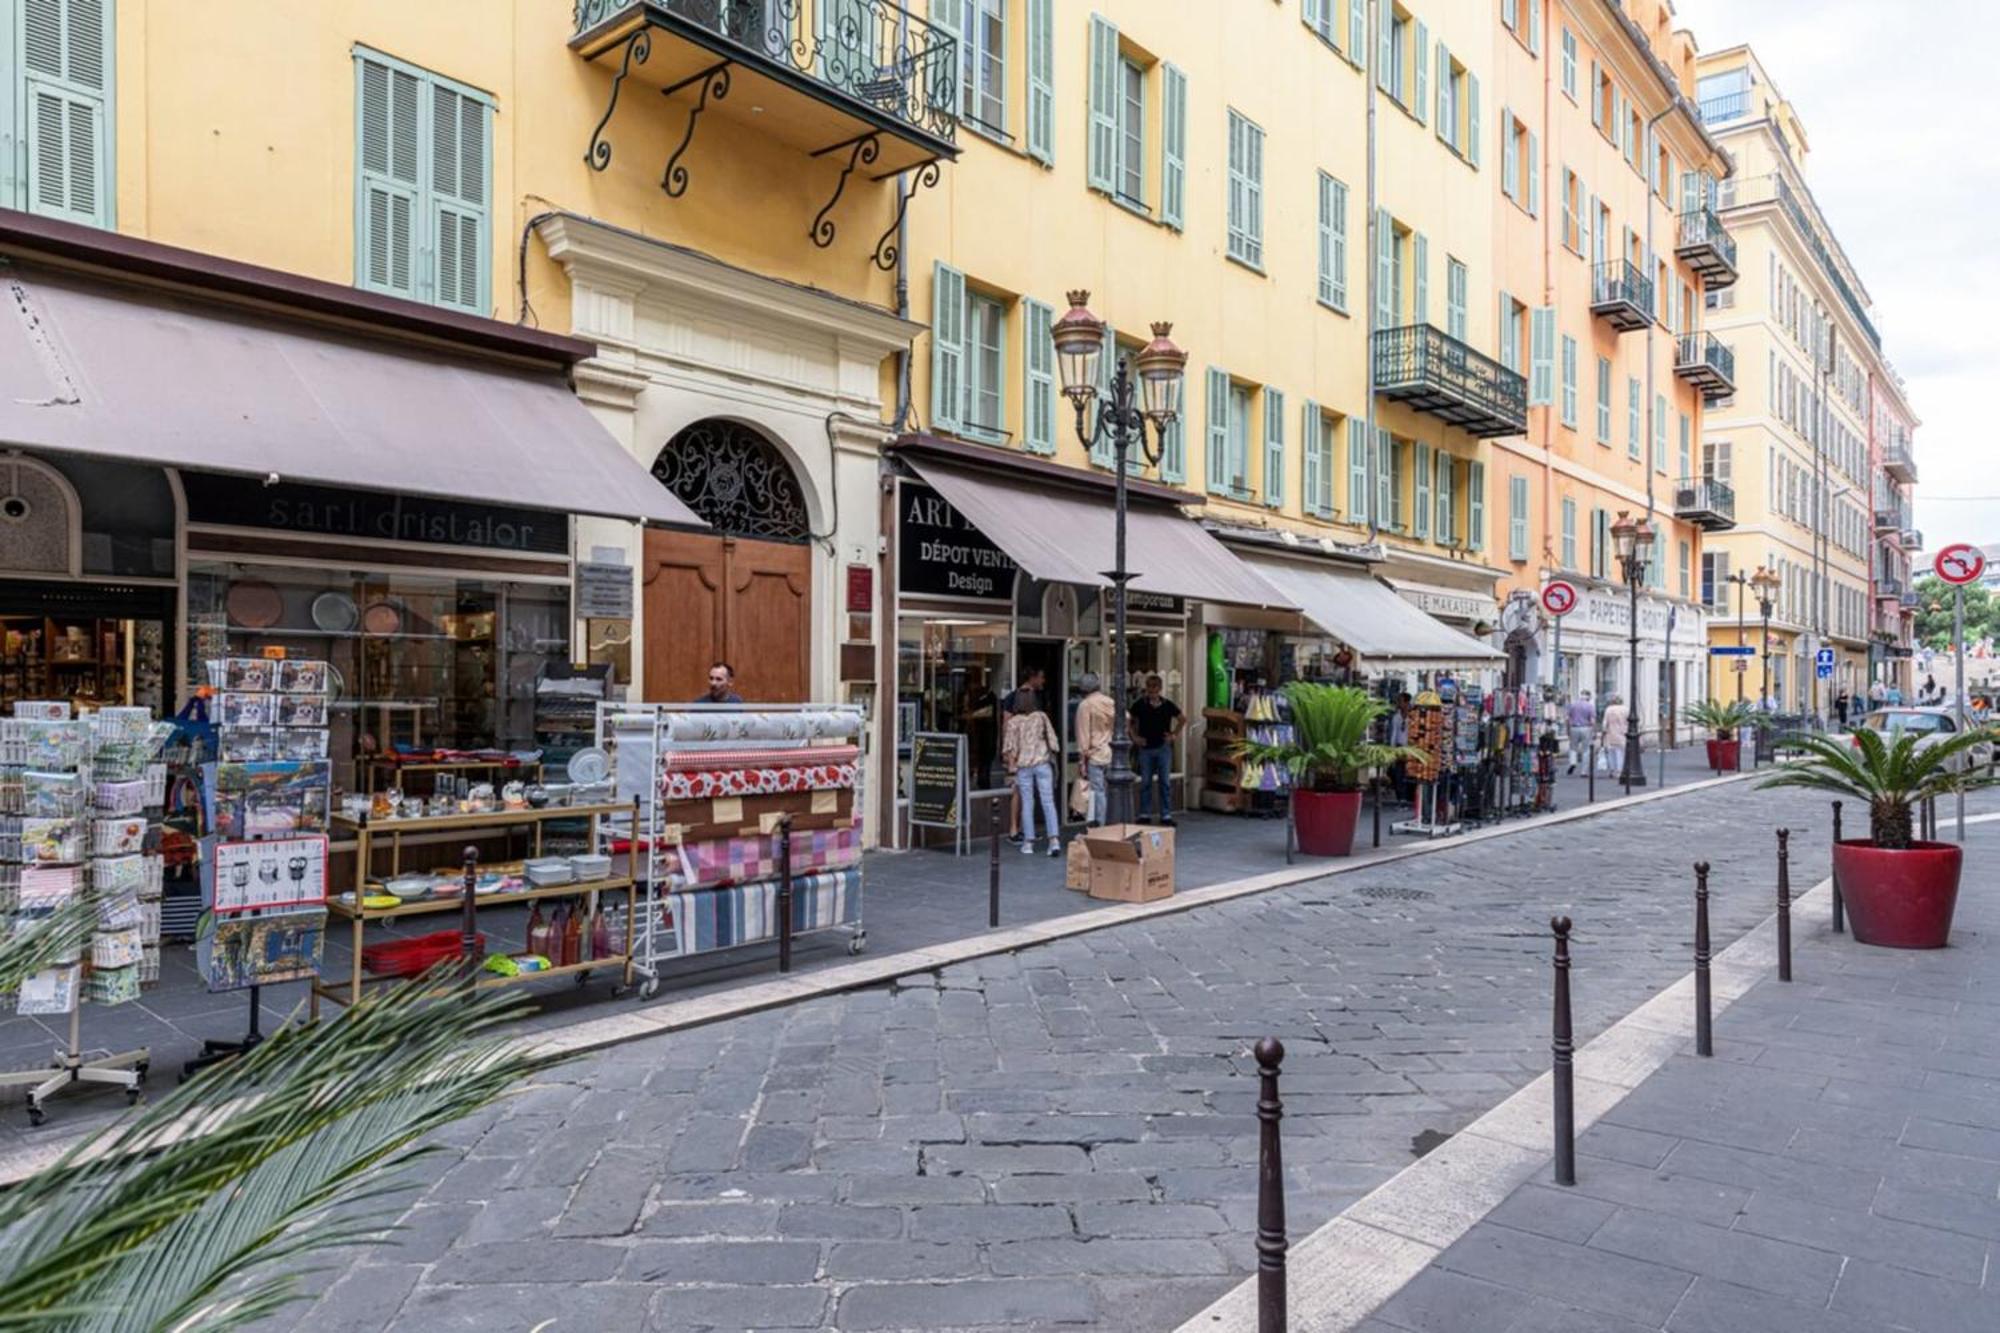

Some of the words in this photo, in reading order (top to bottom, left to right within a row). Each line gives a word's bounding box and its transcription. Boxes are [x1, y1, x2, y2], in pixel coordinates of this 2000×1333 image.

[907, 495, 952, 528] ART
[920, 538, 970, 565] DÉPOT
[948, 571, 993, 595] Design
